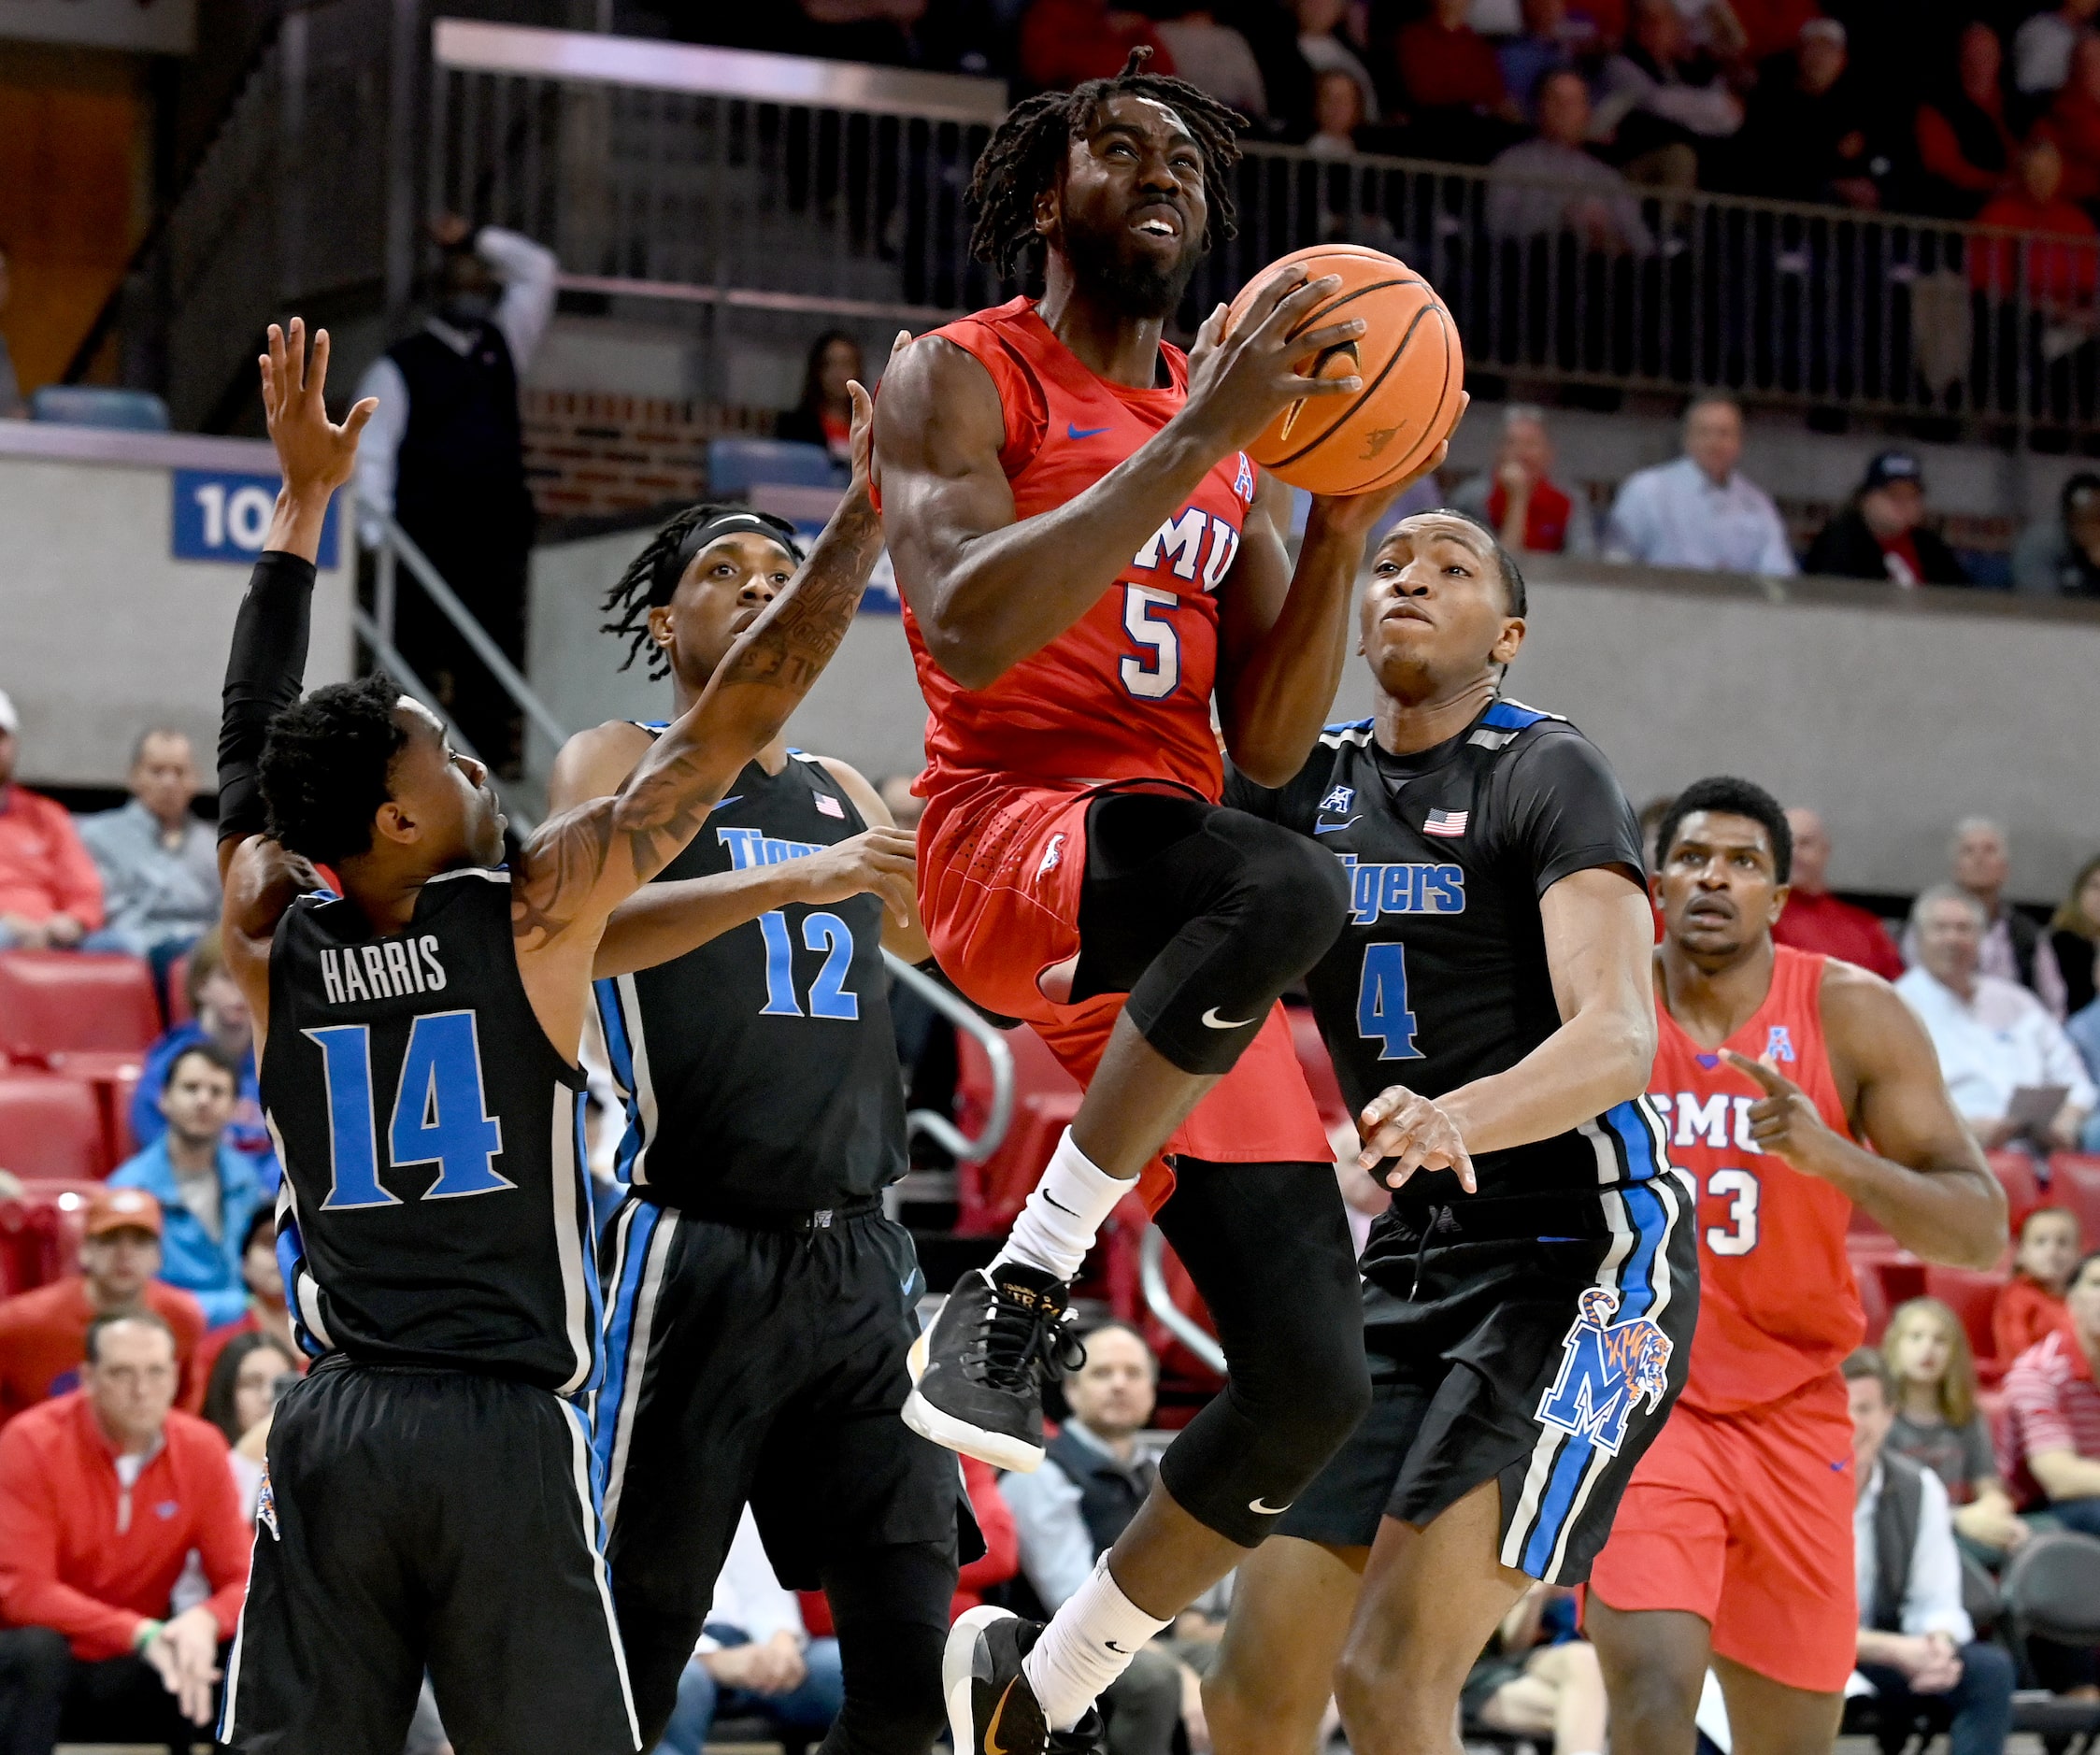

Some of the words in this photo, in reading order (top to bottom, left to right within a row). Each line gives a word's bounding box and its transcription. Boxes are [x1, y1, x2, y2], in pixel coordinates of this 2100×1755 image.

[194, 484, 279, 551] 10
[1133, 507, 1240, 592] MU
[1119, 581, 1180, 701] 5
[1334, 853, 1466, 925] igers
[320, 935, 447, 1004] HARRIS
[757, 909, 859, 1020] 12
[1356, 942, 1426, 1060] 4
[299, 1009, 518, 1210] 14
[1670, 1166, 1761, 1256] 3
